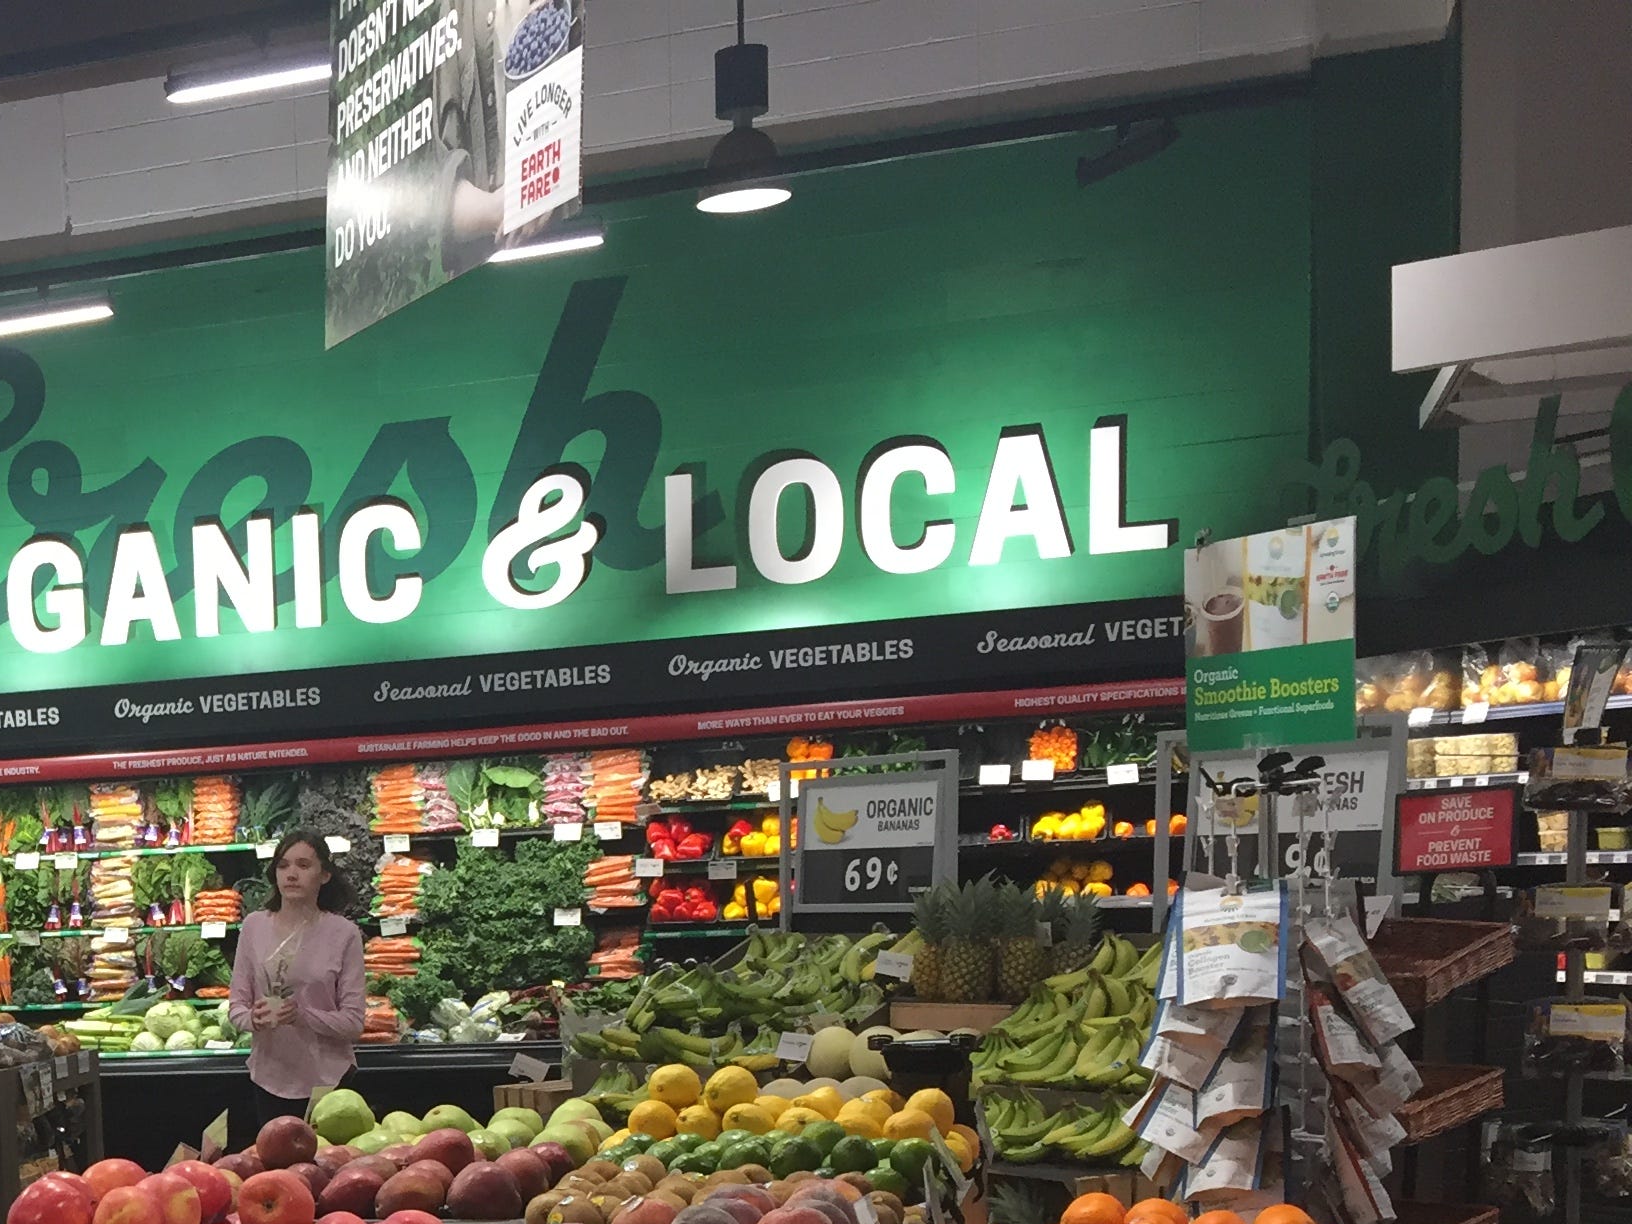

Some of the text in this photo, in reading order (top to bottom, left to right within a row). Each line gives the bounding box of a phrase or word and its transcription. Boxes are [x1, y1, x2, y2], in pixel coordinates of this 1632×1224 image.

[337, 9, 463, 145] PRESERVATIVES.
[512, 81, 572, 147] LIVE LONGER
[368, 97, 433, 184] NEITHER
[533, 121, 550, 141] WITH
[521, 139, 561, 182] EARTH
[520, 173, 551, 209] FARE
[335, 215, 353, 269] DO
[481, 465, 601, 612] &
[665, 422, 1171, 596] LOCAL
[977, 616, 1185, 654] Seasonal VEGET
[668, 639, 914, 681] Organic VEGETABLES
[374, 665, 611, 703] Seasonal VEGETABLES
[1194, 666, 1238, 685] Organic
[1014, 696, 1056, 707] HIGHEST
[1057, 693, 1098, 705] QUALITY
[1100, 687, 1180, 701] SPECIFICATIONS
[1194, 677, 1339, 706] Smoothie Boosters
[114, 687, 321, 724] Organic VEGETABLES
[698, 706, 904, 729] MORE WAYS THAN EVER TO EAT YOUR VEGGIES
[1258, 703, 1295, 717] Functional
[1296, 700, 1335, 714] Superfoods
[358, 742, 411, 752] SUSTAINABLE
[413, 740, 450, 750] FARMING
[500, 734, 516, 743] THE
[543, 731, 552, 740] IN
[553, 730, 571, 739] AND
[573, 729, 589, 737] THE
[591, 727, 608, 736] BAD
[113, 761, 127, 769] THE
[205, 755, 224, 763] JUST
[225, 754, 236, 762] AS
[866, 797, 934, 819] ORGANIC
[1419, 807, 1494, 824] ON PRODUCE
[1441, 796, 1472, 810] SAVE
[878, 819, 920, 832] BANANAS
[1416, 850, 1492, 866] FOOD WASTE
[1428, 838, 1482, 853] PREVENT
